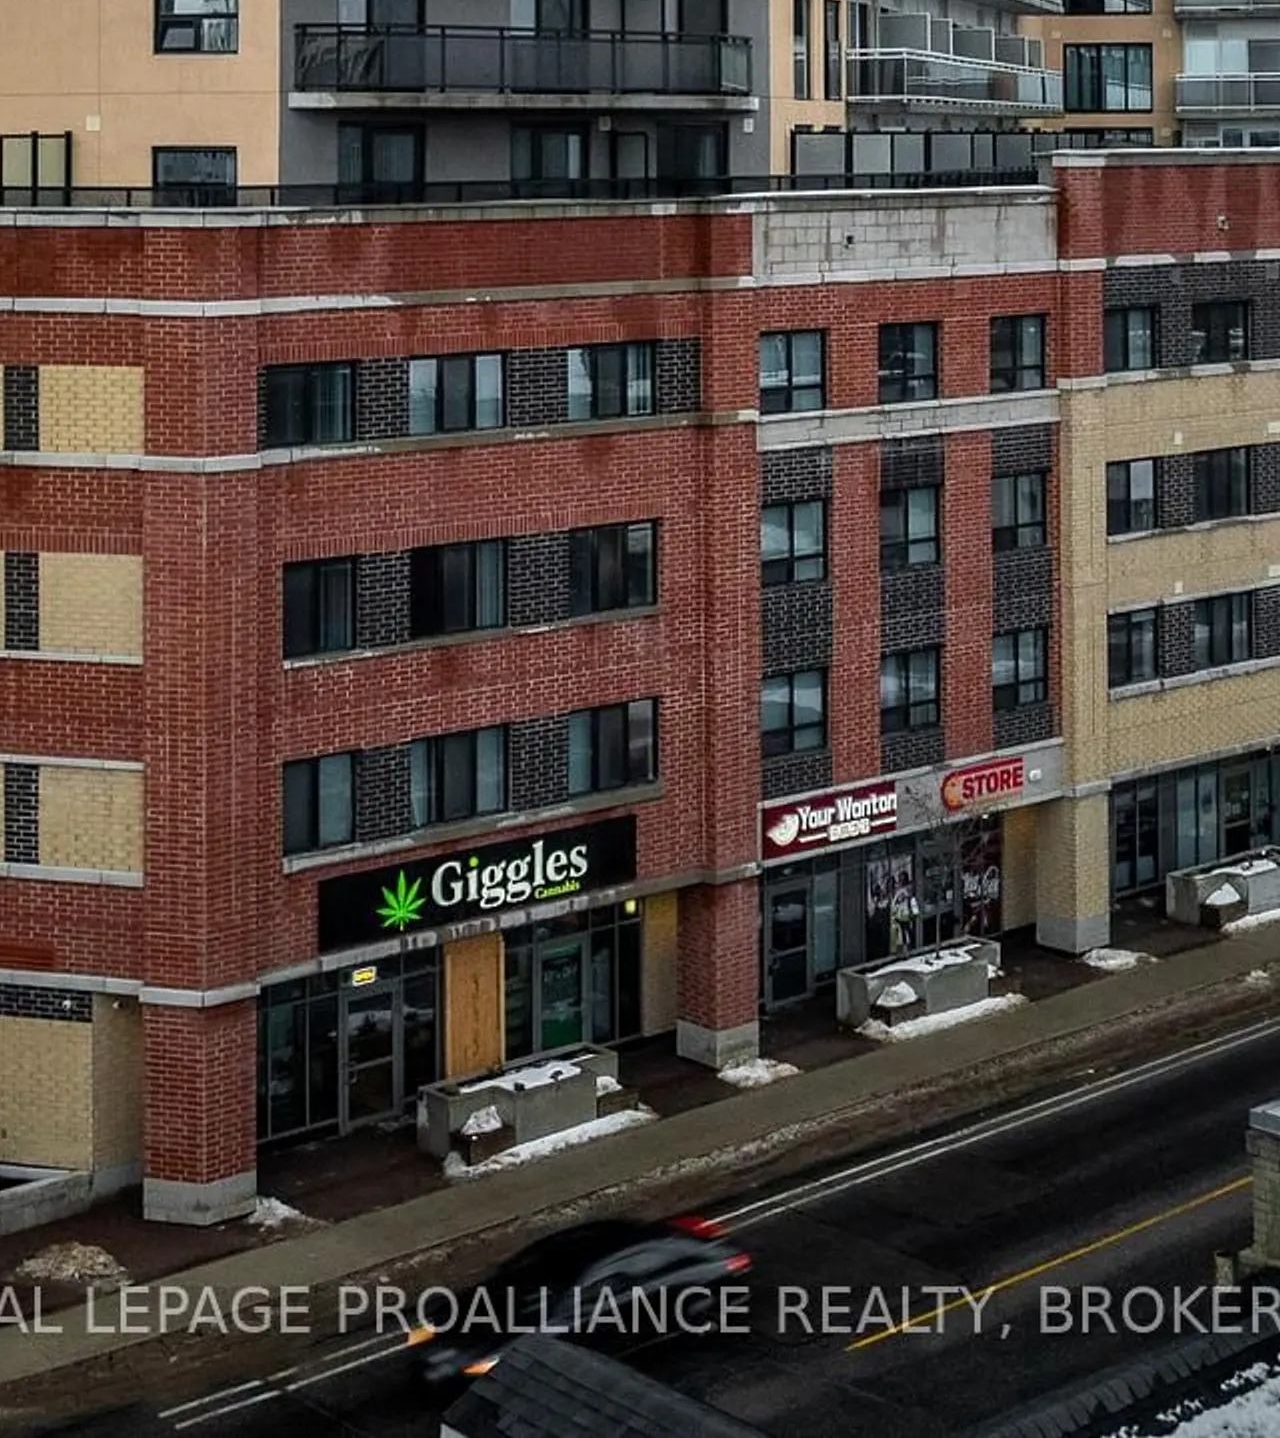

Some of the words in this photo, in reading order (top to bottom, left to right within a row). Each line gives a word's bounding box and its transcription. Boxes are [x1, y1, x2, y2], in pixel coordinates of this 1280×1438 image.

[962, 766, 1024, 799] STORE
[797, 806, 836, 831] Your
[836, 793, 897, 821] Wonton
[431, 839, 588, 909] Giggles
[534, 879, 581, 902] Cannabis
